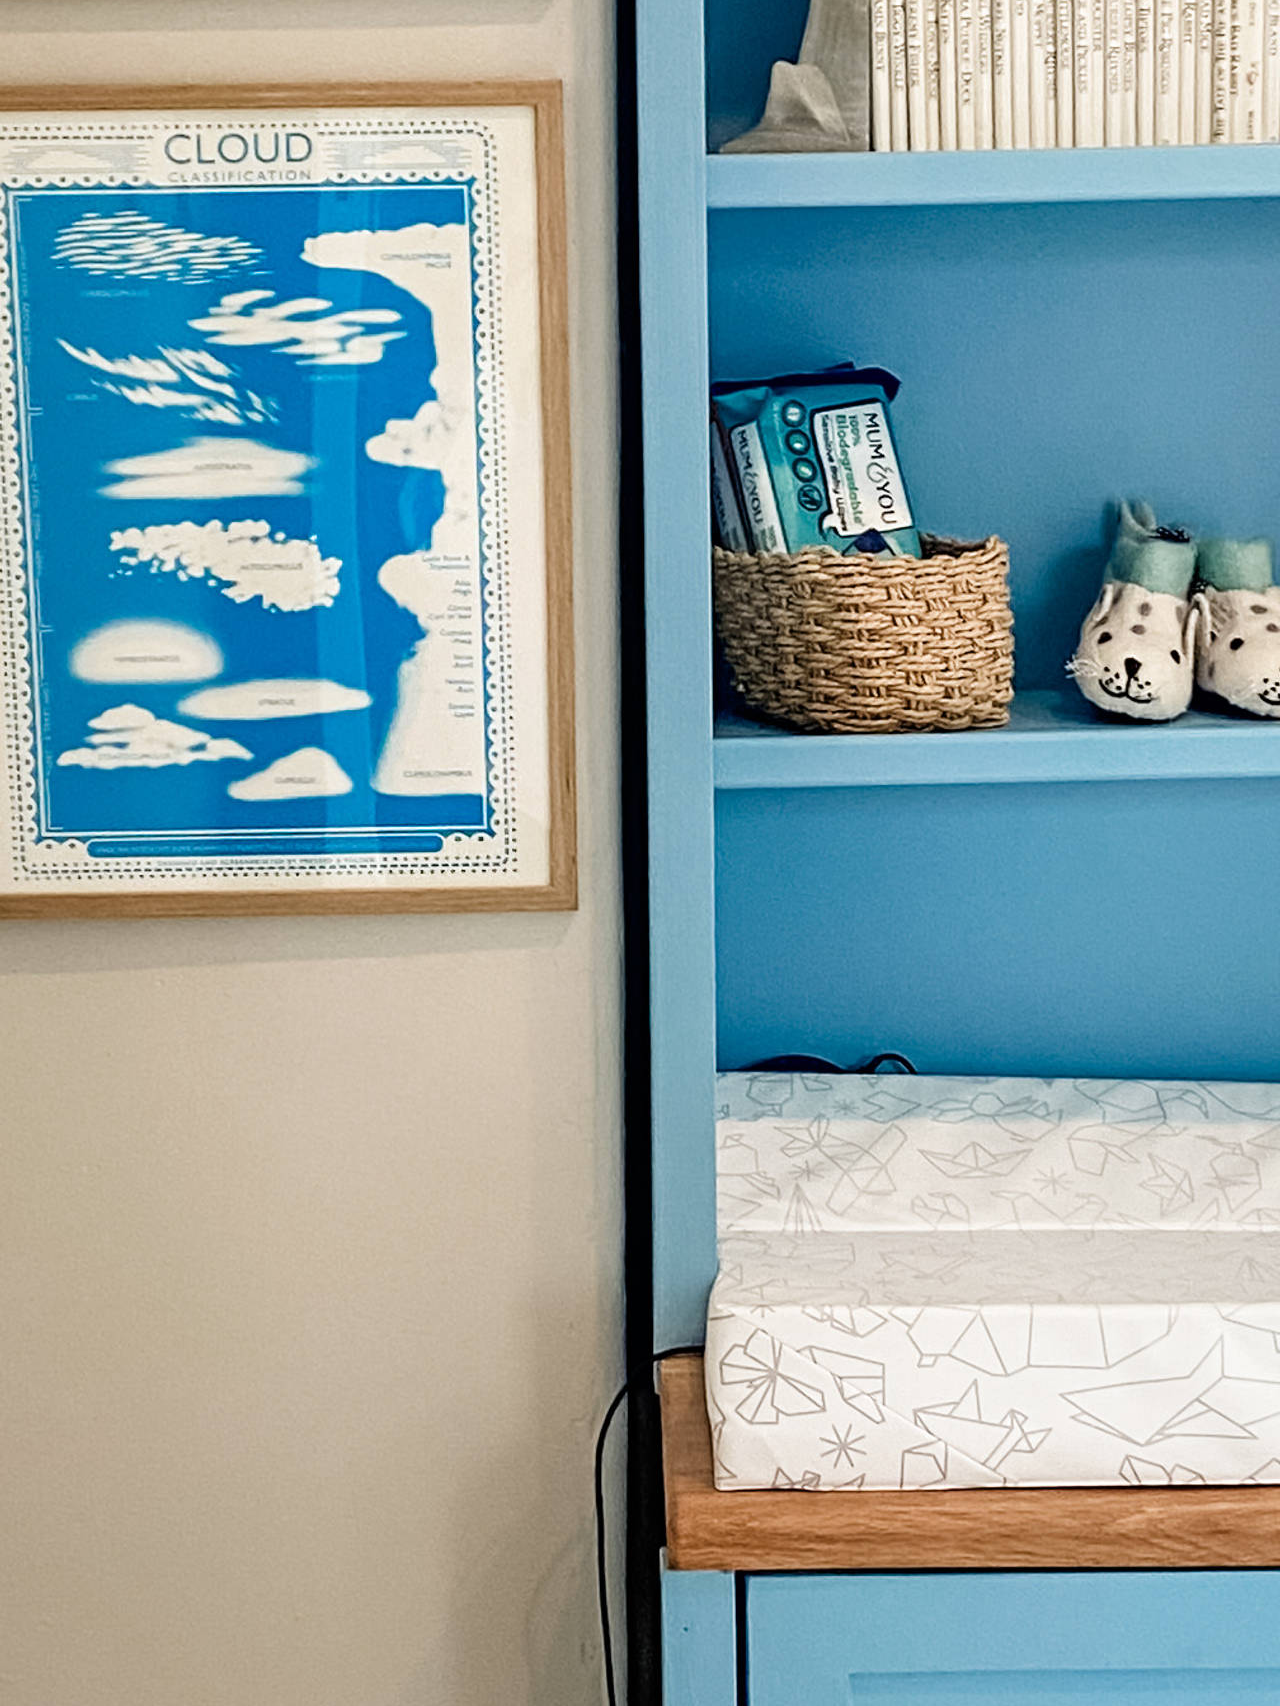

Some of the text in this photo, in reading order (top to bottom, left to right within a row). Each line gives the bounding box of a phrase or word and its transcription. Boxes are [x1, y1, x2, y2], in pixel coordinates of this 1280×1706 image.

[164, 132, 312, 164] CLOUD
[167, 169, 312, 183] CLASSIFICATION
[848, 414, 861, 447] 100%
[737, 429, 752, 470] MUM
[748, 487, 764, 524] YOU
[863, 412, 886, 460] MUM
[876, 480, 898, 525] YOU
